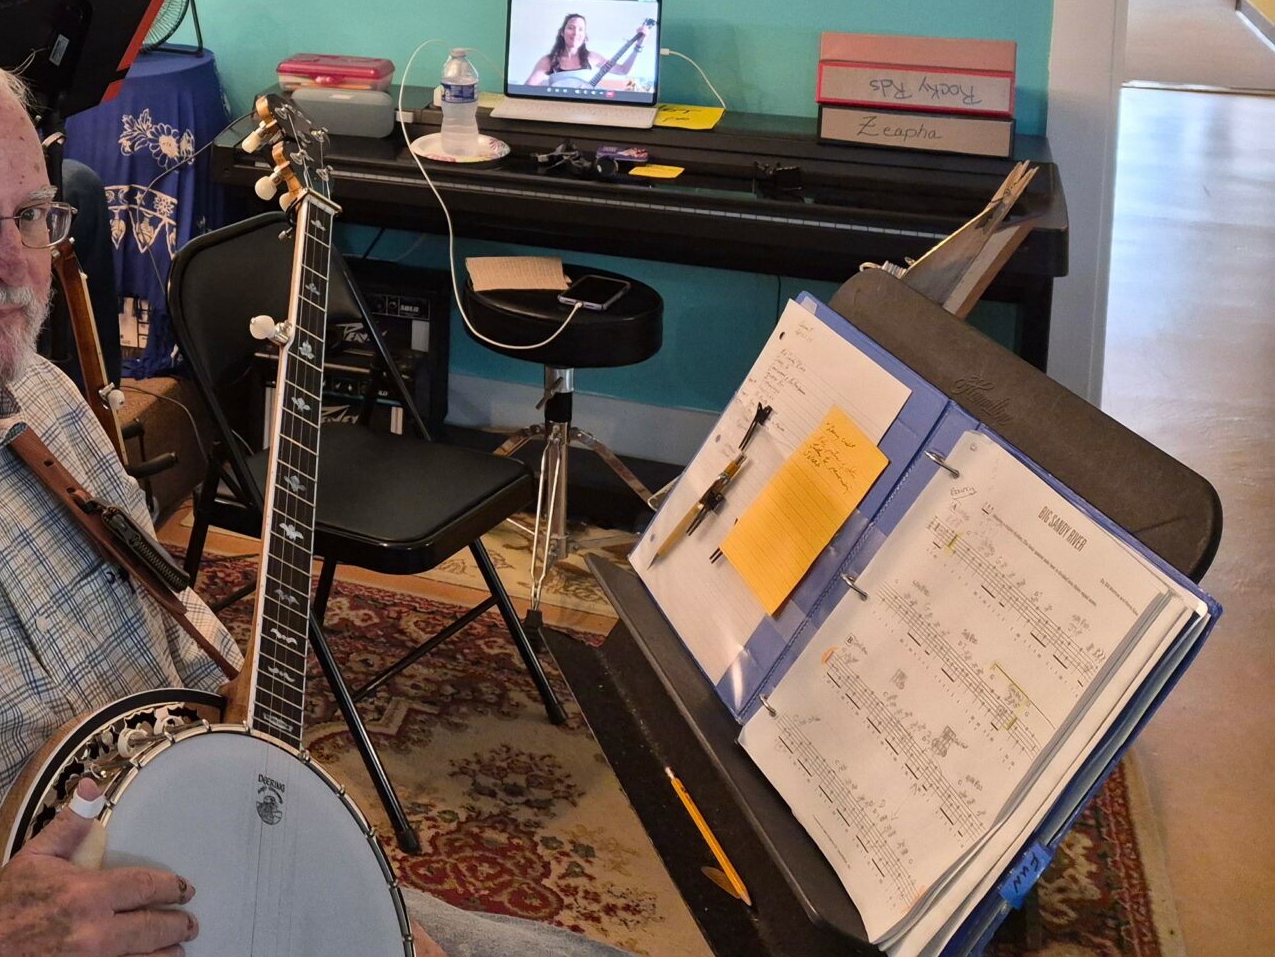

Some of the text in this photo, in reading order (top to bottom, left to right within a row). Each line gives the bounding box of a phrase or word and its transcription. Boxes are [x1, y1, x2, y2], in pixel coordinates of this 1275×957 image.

[869, 77, 982, 105] Rocky Rds
[1038, 505, 1054, 524] BIG
[1048, 514, 1072, 539] SANDY
[1066, 529, 1088, 552] RIVER
[258, 774, 285, 793] DEERING
